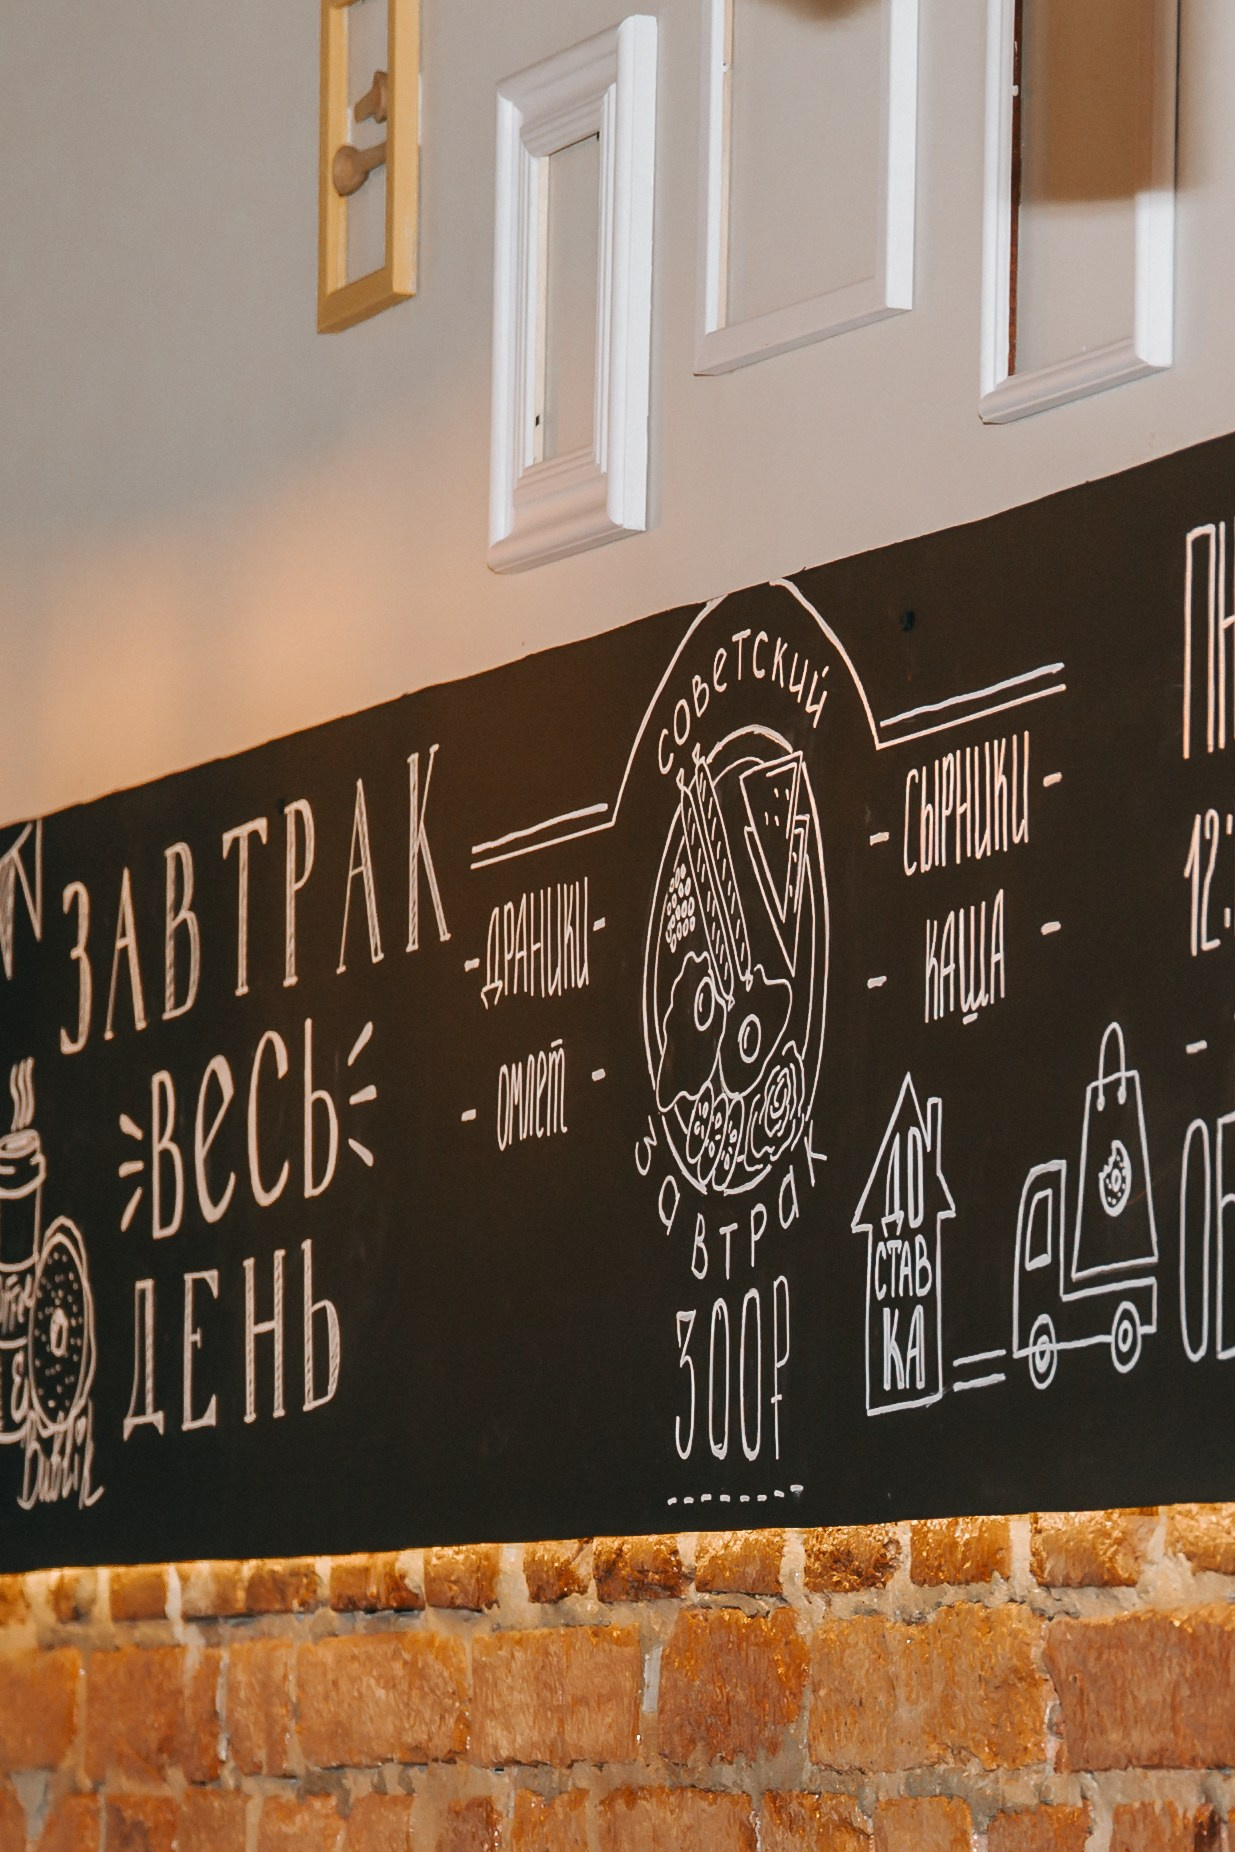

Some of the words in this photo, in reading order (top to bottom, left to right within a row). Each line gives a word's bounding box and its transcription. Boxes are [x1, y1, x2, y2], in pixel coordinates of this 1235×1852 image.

[903, 730, 1030, 877] СЫРНИКИ
[60, 743, 452, 1055] ЗАВТРАК
[480, 876, 590, 1010] ДРАНИКИ
[924, 888, 1006, 1026] КАША
[123, 1239, 341, 1441] ДЕНЬ
